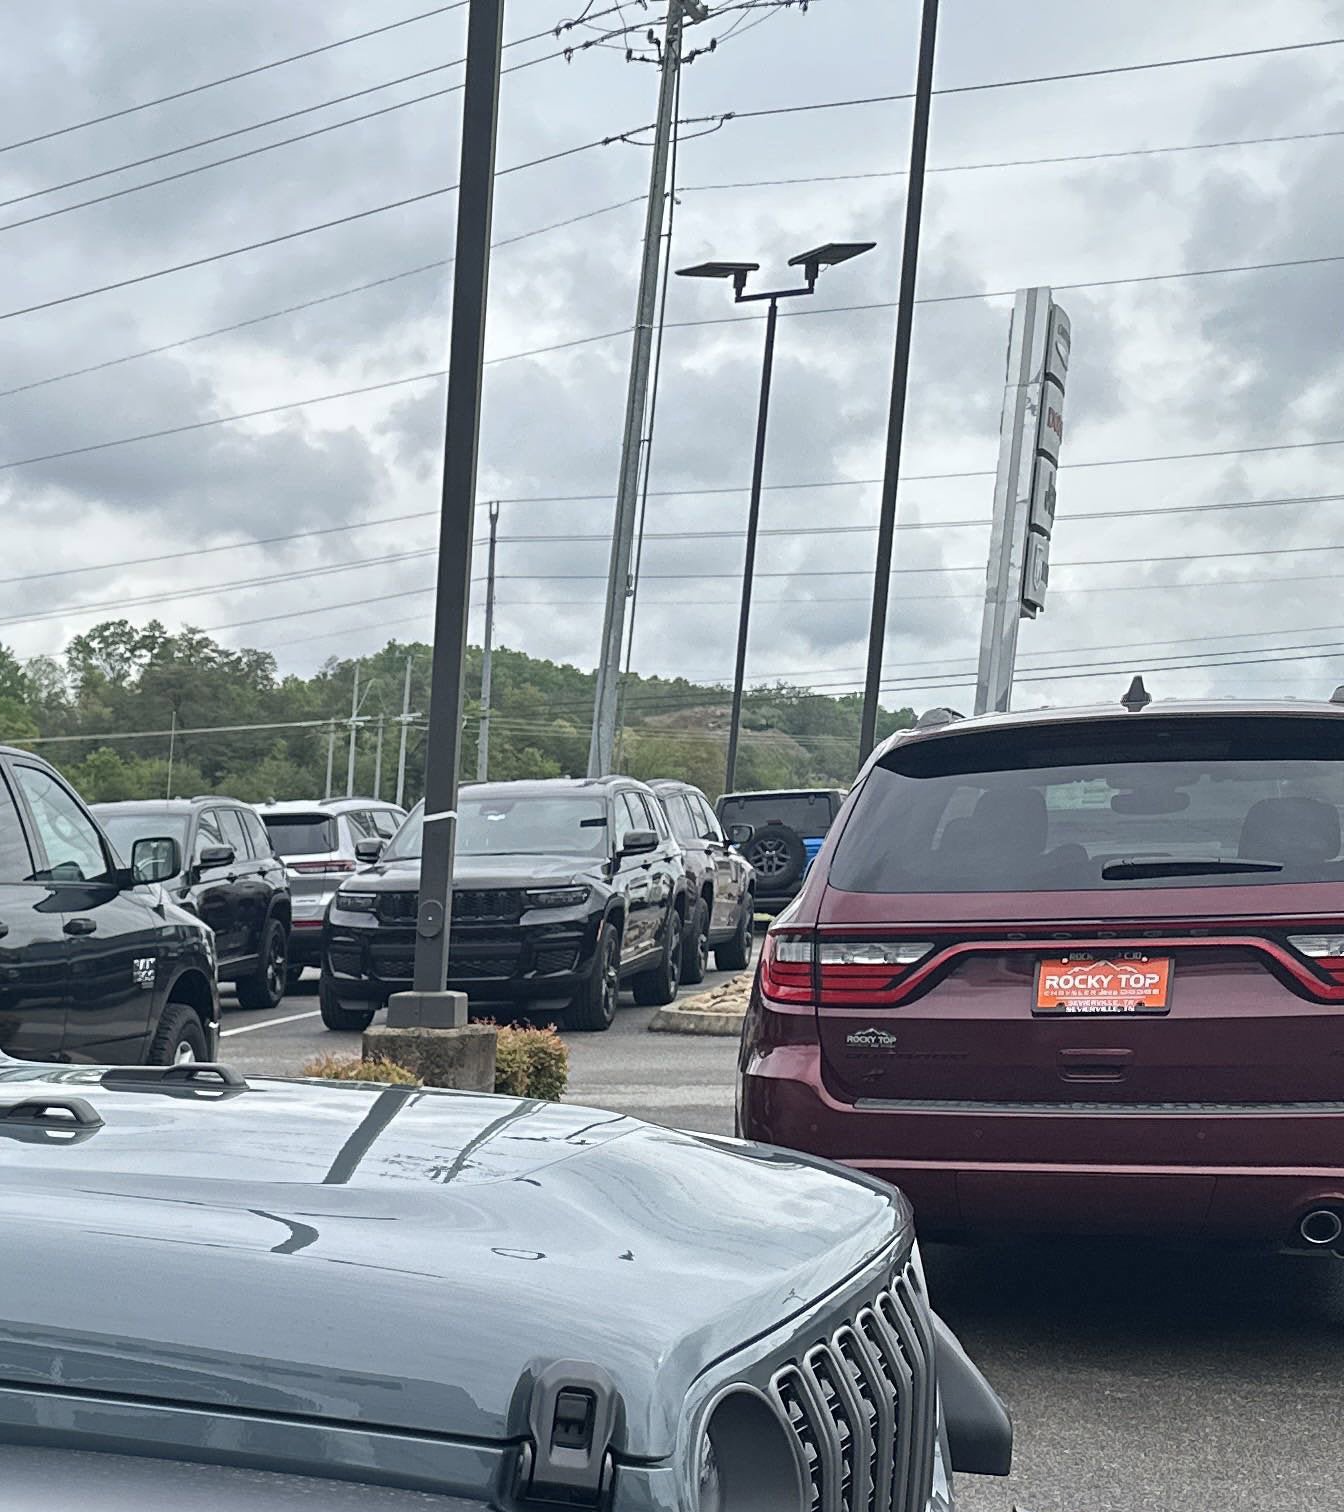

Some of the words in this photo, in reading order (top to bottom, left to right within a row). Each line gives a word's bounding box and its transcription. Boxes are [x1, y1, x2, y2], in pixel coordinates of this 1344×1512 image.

[1045, 974, 1113, 989] ROCKY
[1118, 974, 1160, 988] TOP
[846, 1035, 876, 1044] ROCKY
[878, 1035, 897, 1045] TOP
